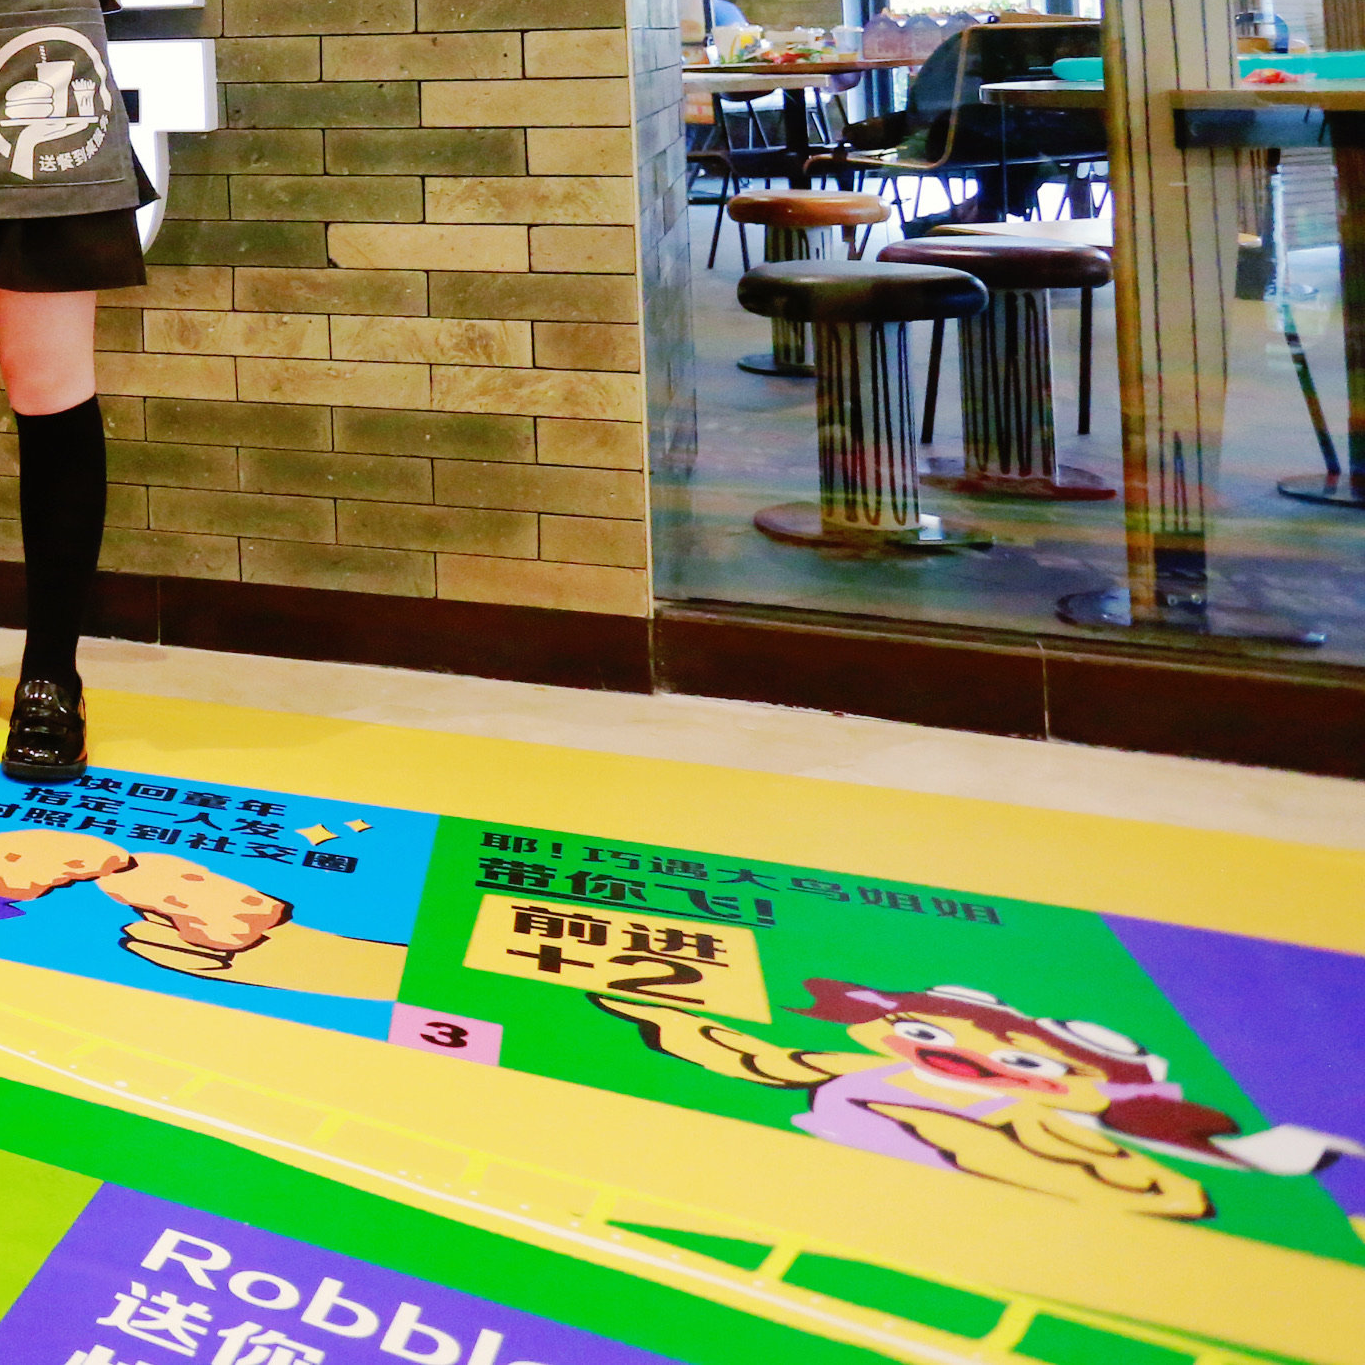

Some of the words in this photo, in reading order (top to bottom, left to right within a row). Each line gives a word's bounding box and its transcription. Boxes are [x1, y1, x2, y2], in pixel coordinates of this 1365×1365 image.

[21, 786, 285, 840] 指定一人发
[476, 855, 776, 927] 带你飞！
[510, 904, 729, 969] 前进
[505, 943, 706, 1006] +2
[419, 1022, 470, 1051] 3
[139, 1227, 554, 1365] Robbl
